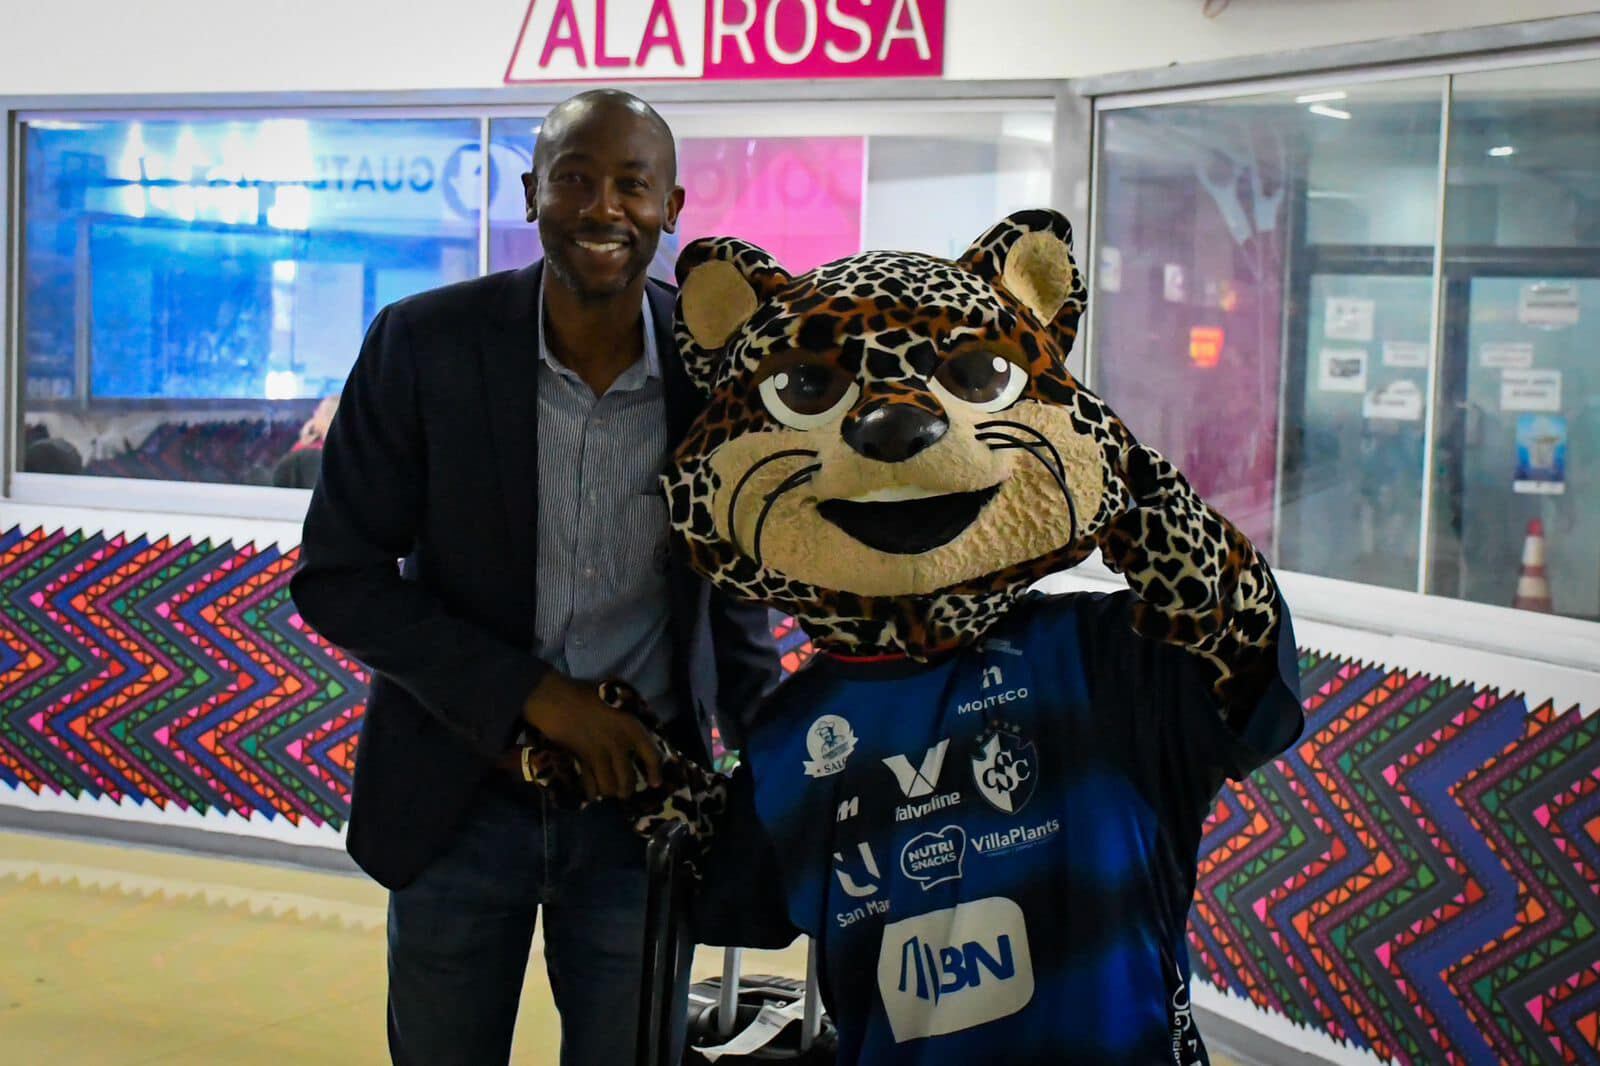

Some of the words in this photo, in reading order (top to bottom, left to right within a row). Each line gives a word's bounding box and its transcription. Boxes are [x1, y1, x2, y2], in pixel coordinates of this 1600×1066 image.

[538, 0, 685, 68] ALA
[711, 0, 931, 64] ROSA
[970, 818, 1061, 853] VillaPlants
[908, 840, 954, 862] NUTRI
[911, 851, 957, 872] SNACKS
[836, 908, 866, 928] San
